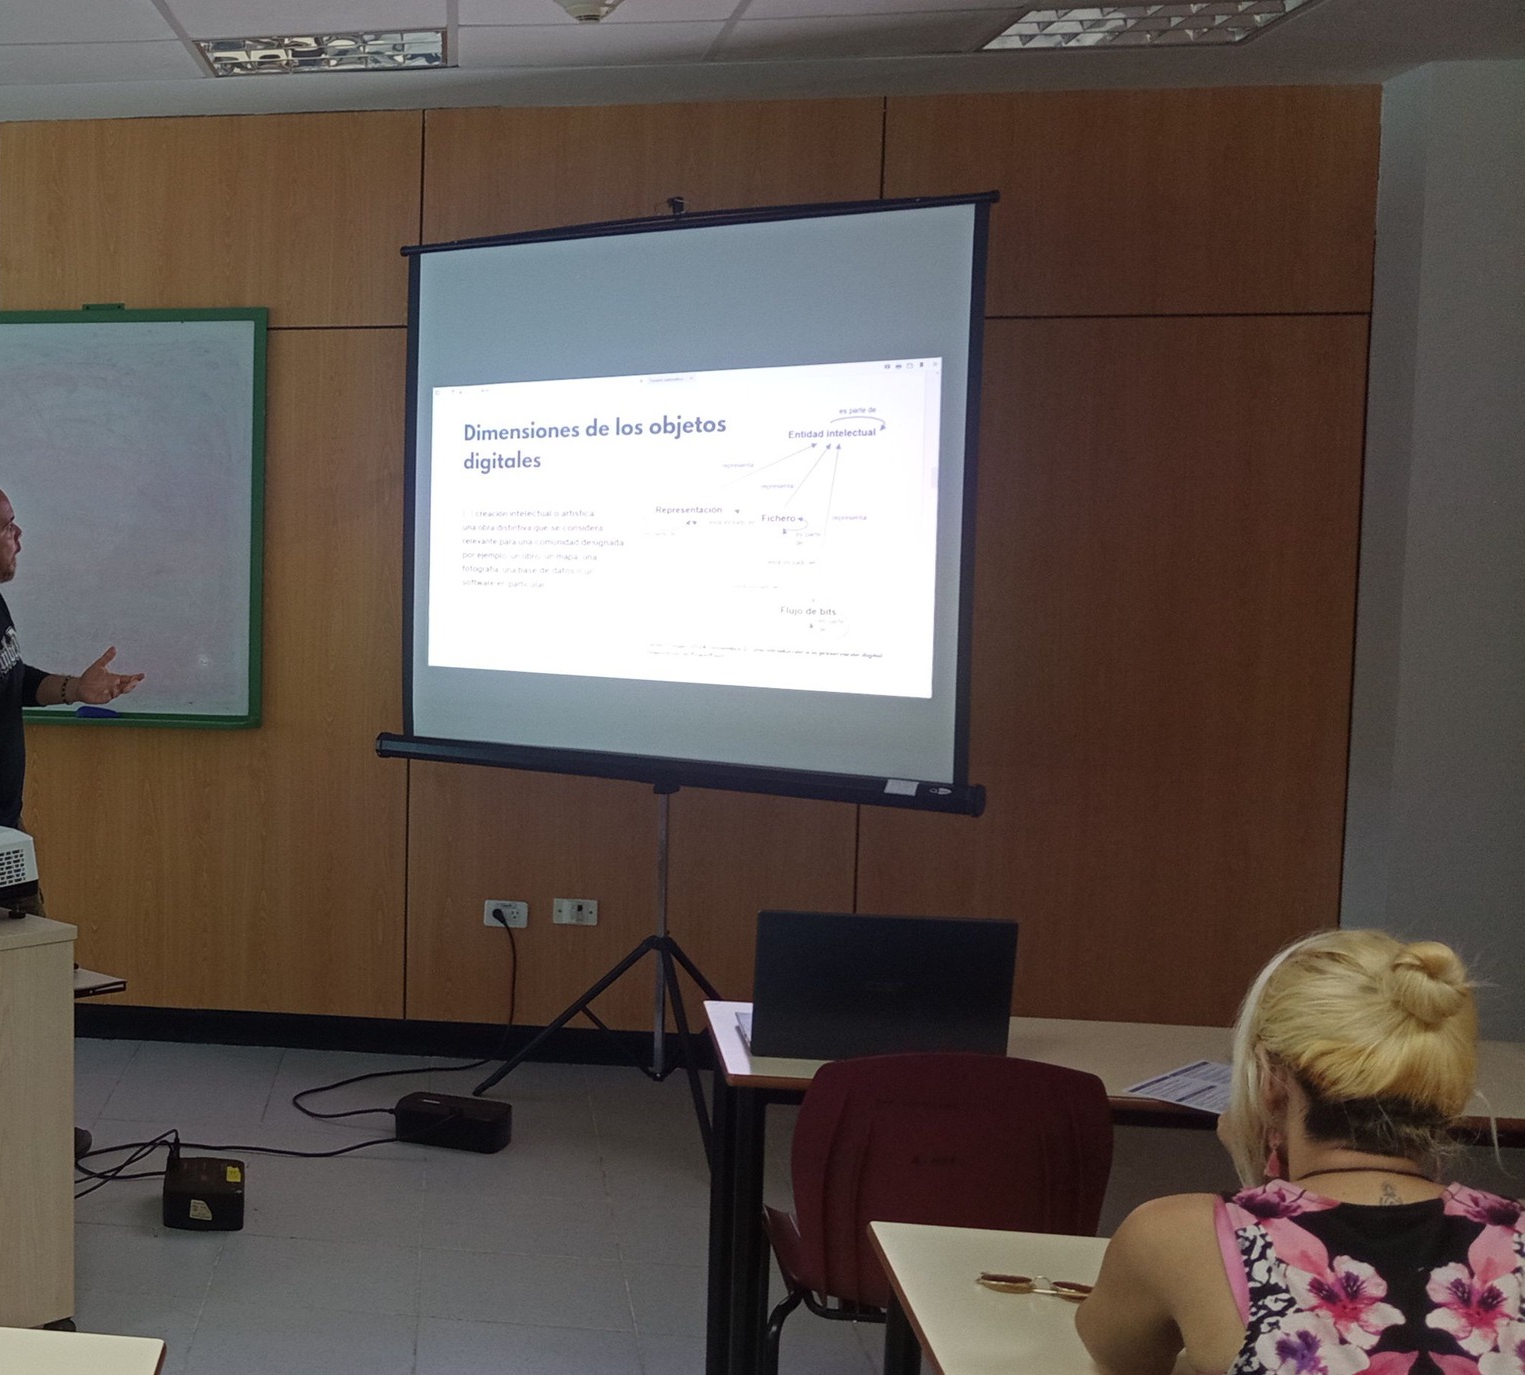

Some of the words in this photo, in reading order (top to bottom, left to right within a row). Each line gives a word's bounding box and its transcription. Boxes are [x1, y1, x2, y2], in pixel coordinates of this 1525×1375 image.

[464, 421, 580, 441] Dimensiones
[585, 418, 610, 436] de
[616, 417, 643, 436] los
[649, 415, 726, 439] objetos
[788, 430, 824, 439] Entidad
[826, 428, 877, 438] intelectual
[464, 450, 541, 474] digitales
[655, 506, 723, 515] Representación
[761, 514, 796, 523] Fichero
[780, 606, 803, 616] Flujo
[806, 607, 817, 616] de
[819, 607, 837, 616] bits
